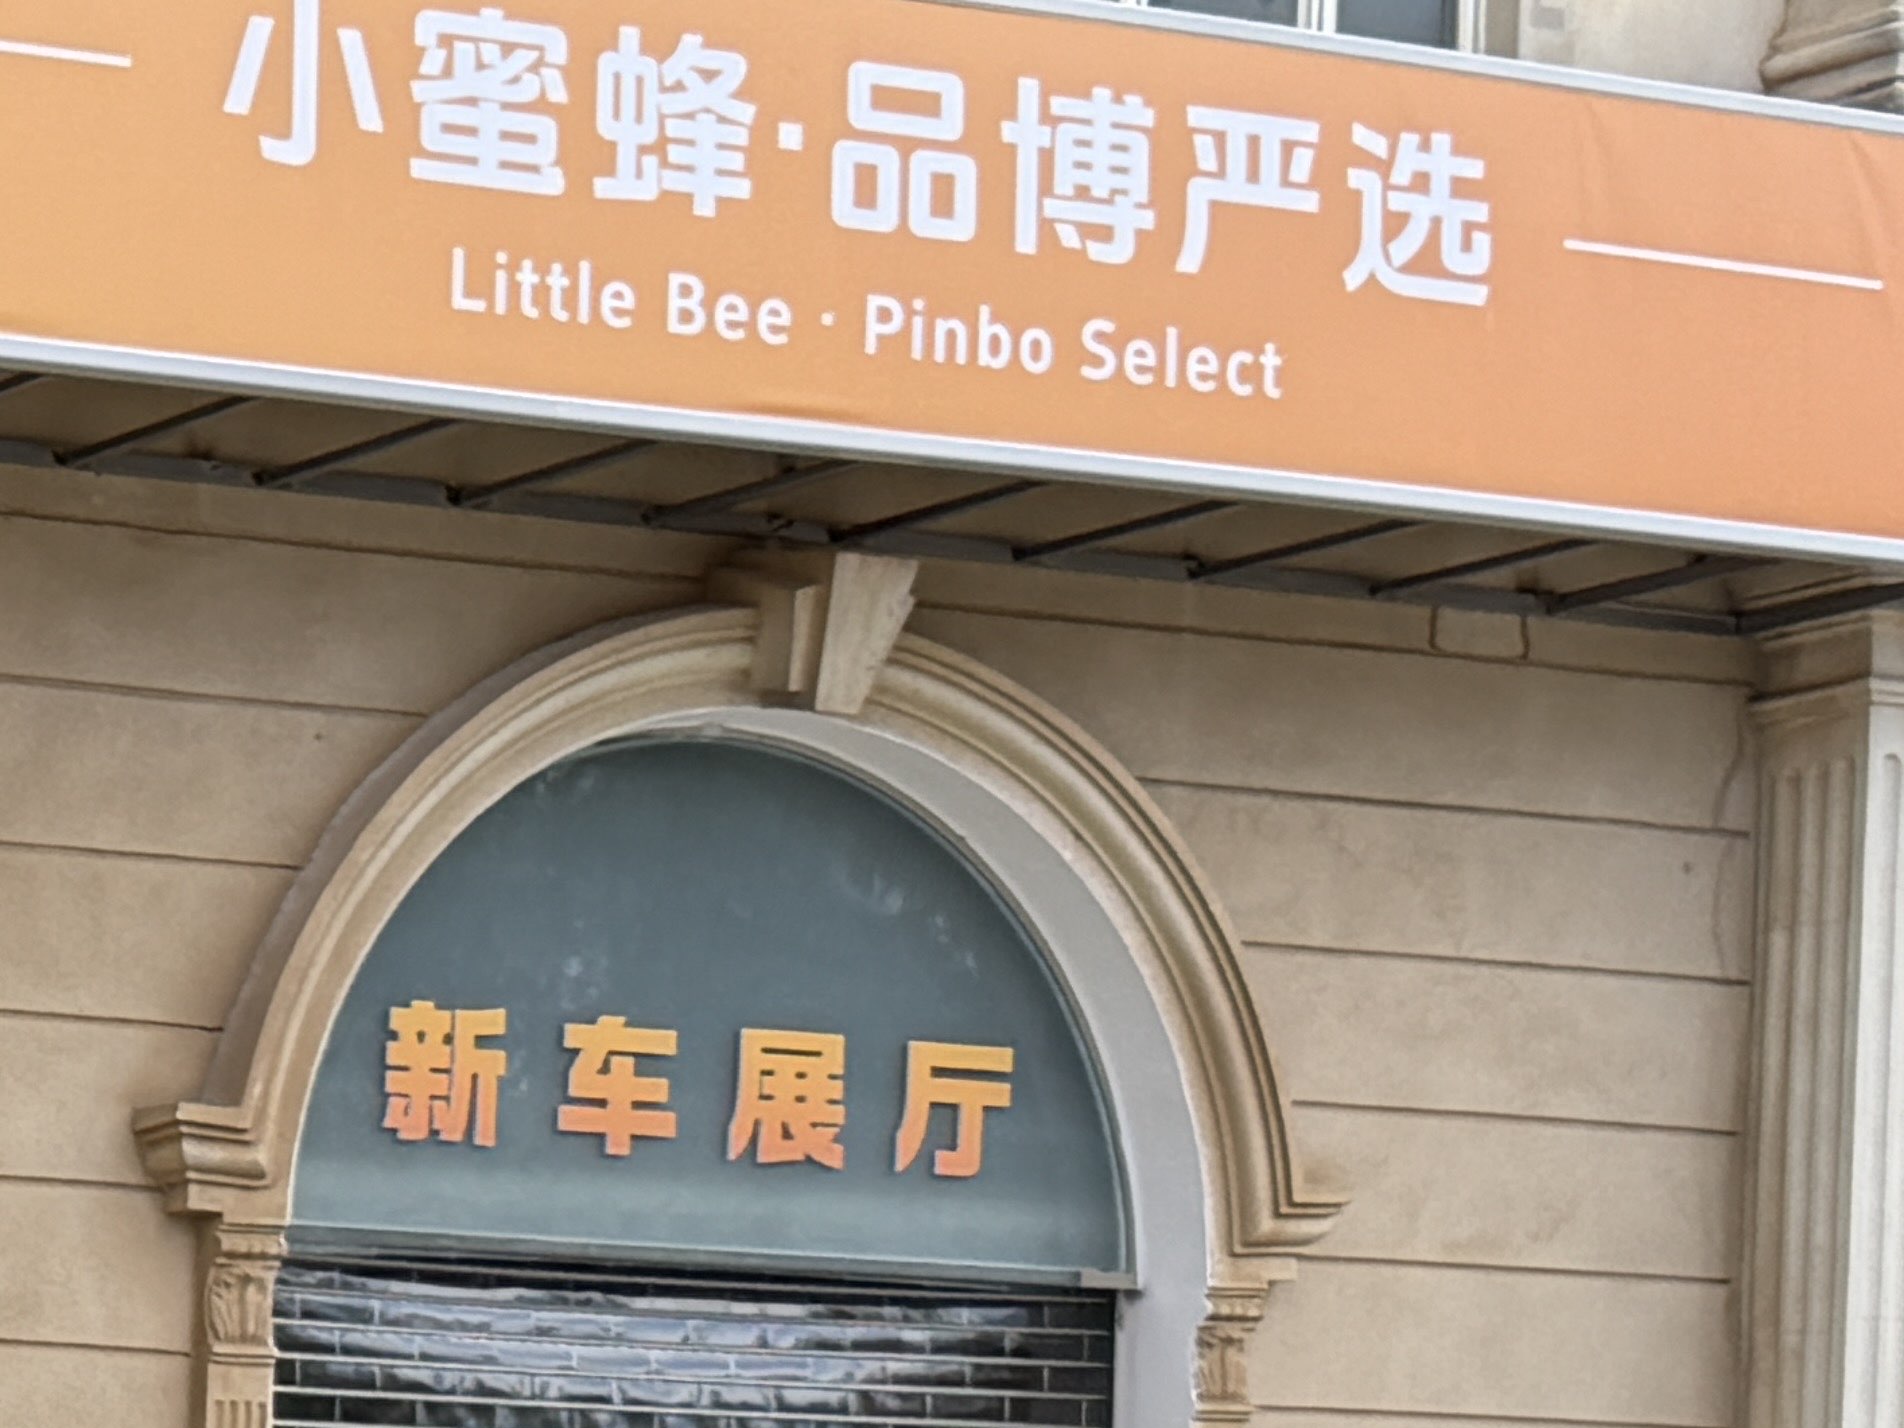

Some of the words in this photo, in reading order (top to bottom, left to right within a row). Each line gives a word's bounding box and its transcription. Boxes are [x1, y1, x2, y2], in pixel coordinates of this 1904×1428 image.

[222, 0, 1492, 307] 小蜜蜂·品博严选
[451, 247, 636, 329] Little
[667, 272, 792, 345] Bee
[864, 294, 1055, 374] Pinbo
[1080, 318, 1282, 399] Select
[383, 1000, 1015, 1178] 新车展厅
